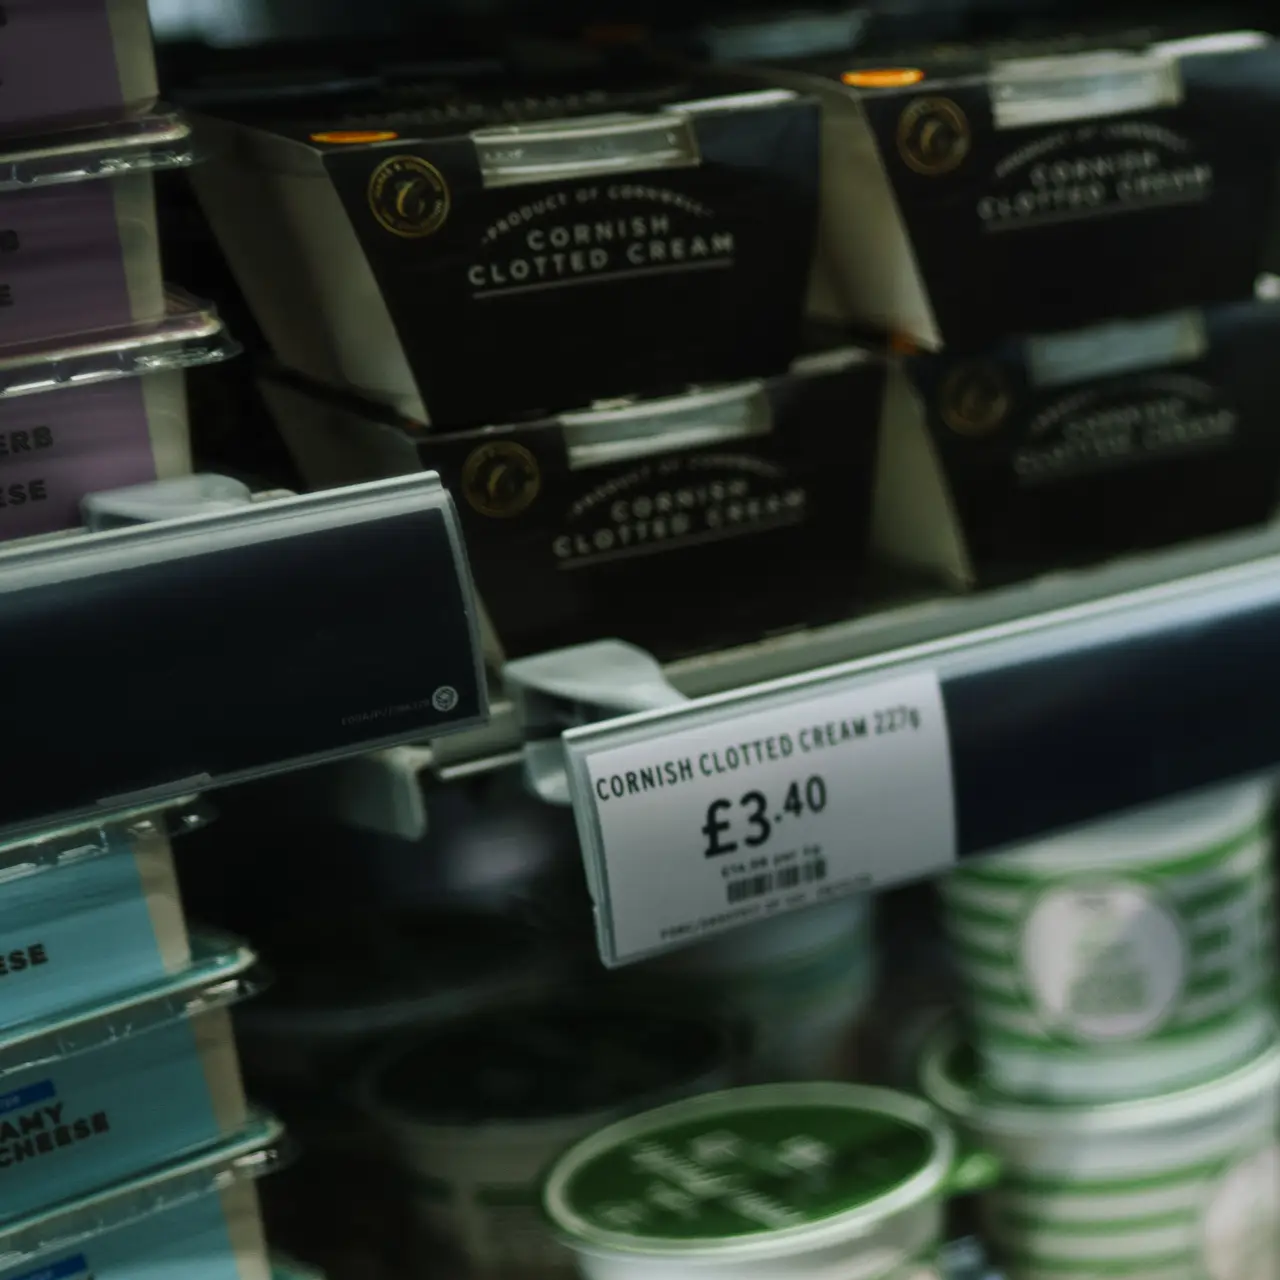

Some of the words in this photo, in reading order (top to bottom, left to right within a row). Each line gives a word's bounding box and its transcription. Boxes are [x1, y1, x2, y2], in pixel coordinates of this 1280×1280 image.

[468, 249, 608, 286] CLOTTED
[626, 231, 734, 264] CREAM
[527, 214, 670, 250] CORNISH
[552, 512, 691, 558] CLOTTED
[596, 758, 695, 801] CORNISH
[699, 733, 794, 778] CLOTTED
[798, 712, 869, 753] CREAM
[874, 704, 922, 736] 227g
[702, 774, 828, 859] £3.40
